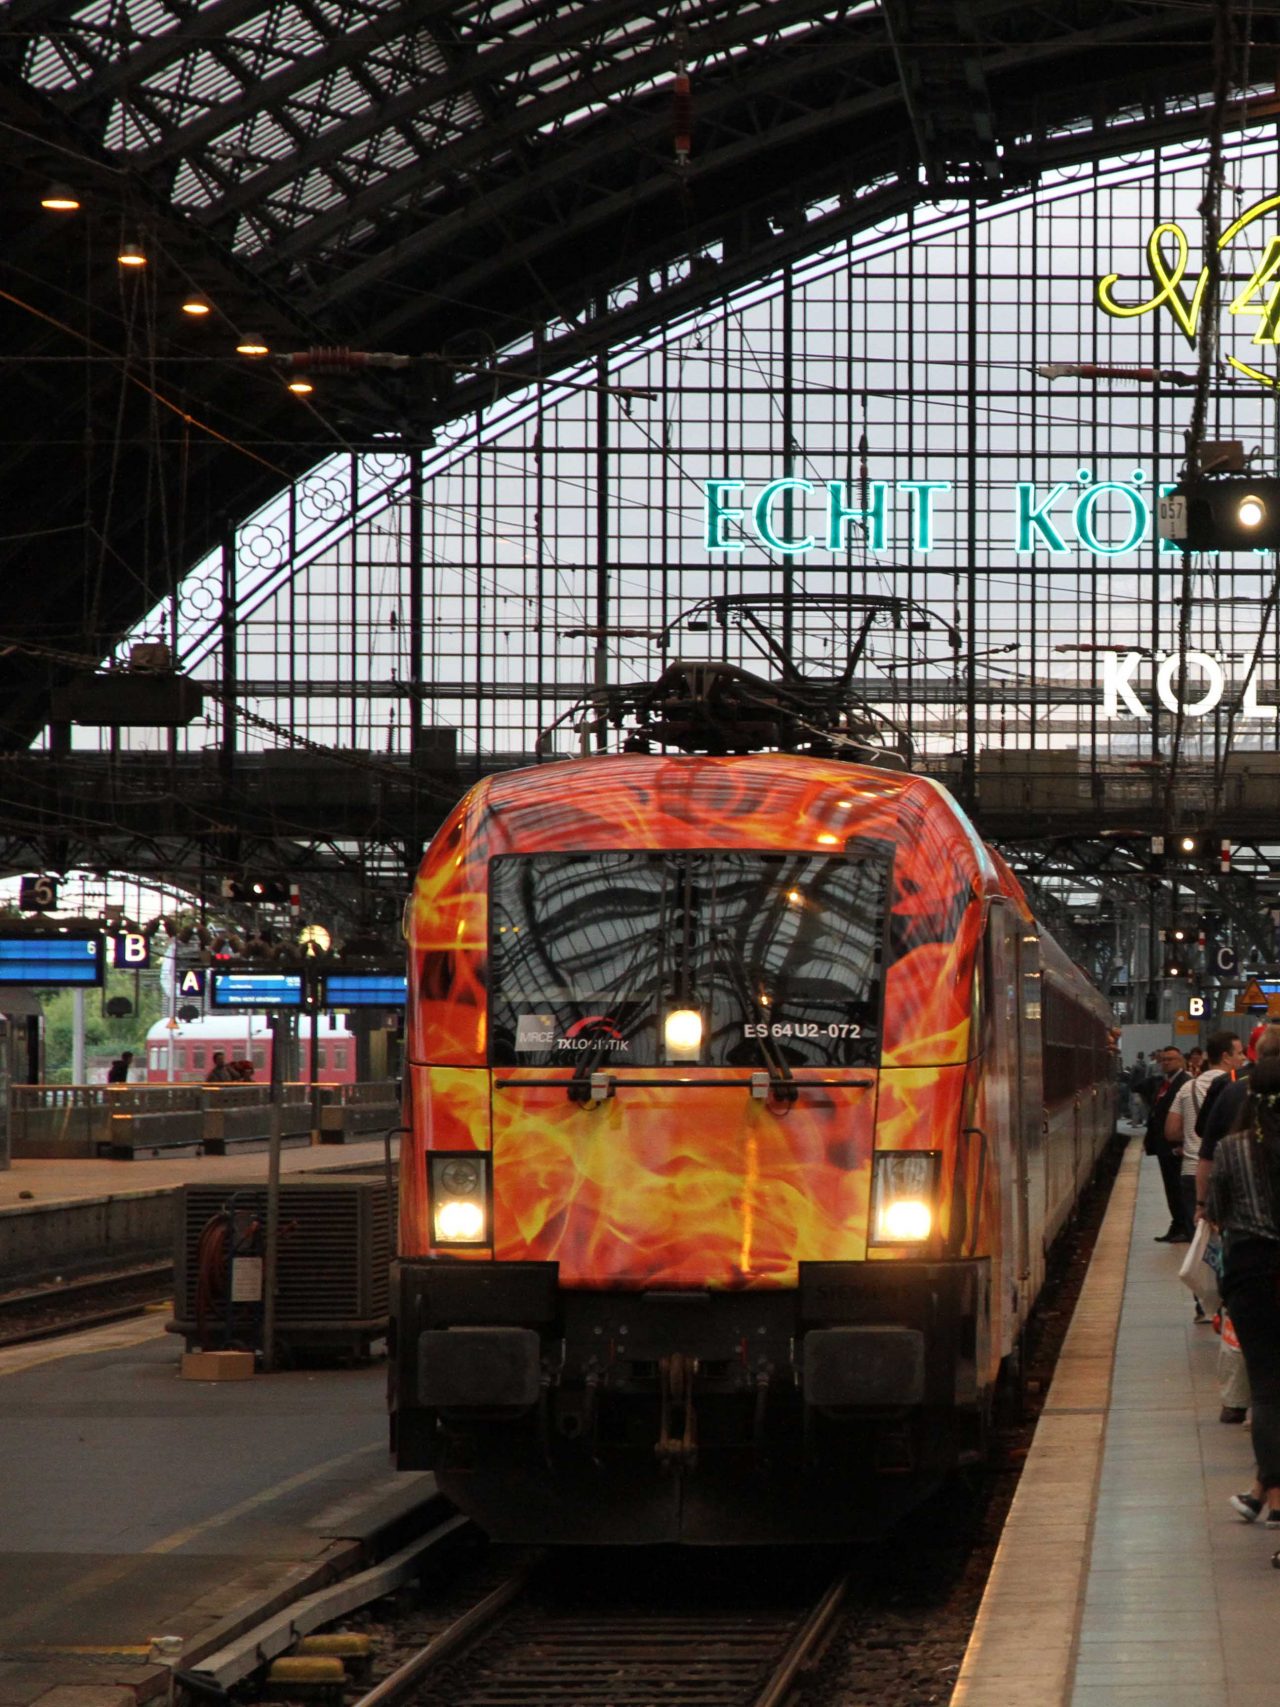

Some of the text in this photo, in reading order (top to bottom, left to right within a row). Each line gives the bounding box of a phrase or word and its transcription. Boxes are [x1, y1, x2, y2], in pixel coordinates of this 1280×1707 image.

[703, 477, 952, 554] ECHT
[124, 933, 146, 962] B
[1216, 947, 1235, 970] C
[182, 970, 199, 991] A
[1189, 997, 1205, 1016] B
[743, 1023, 769, 1038] ES
